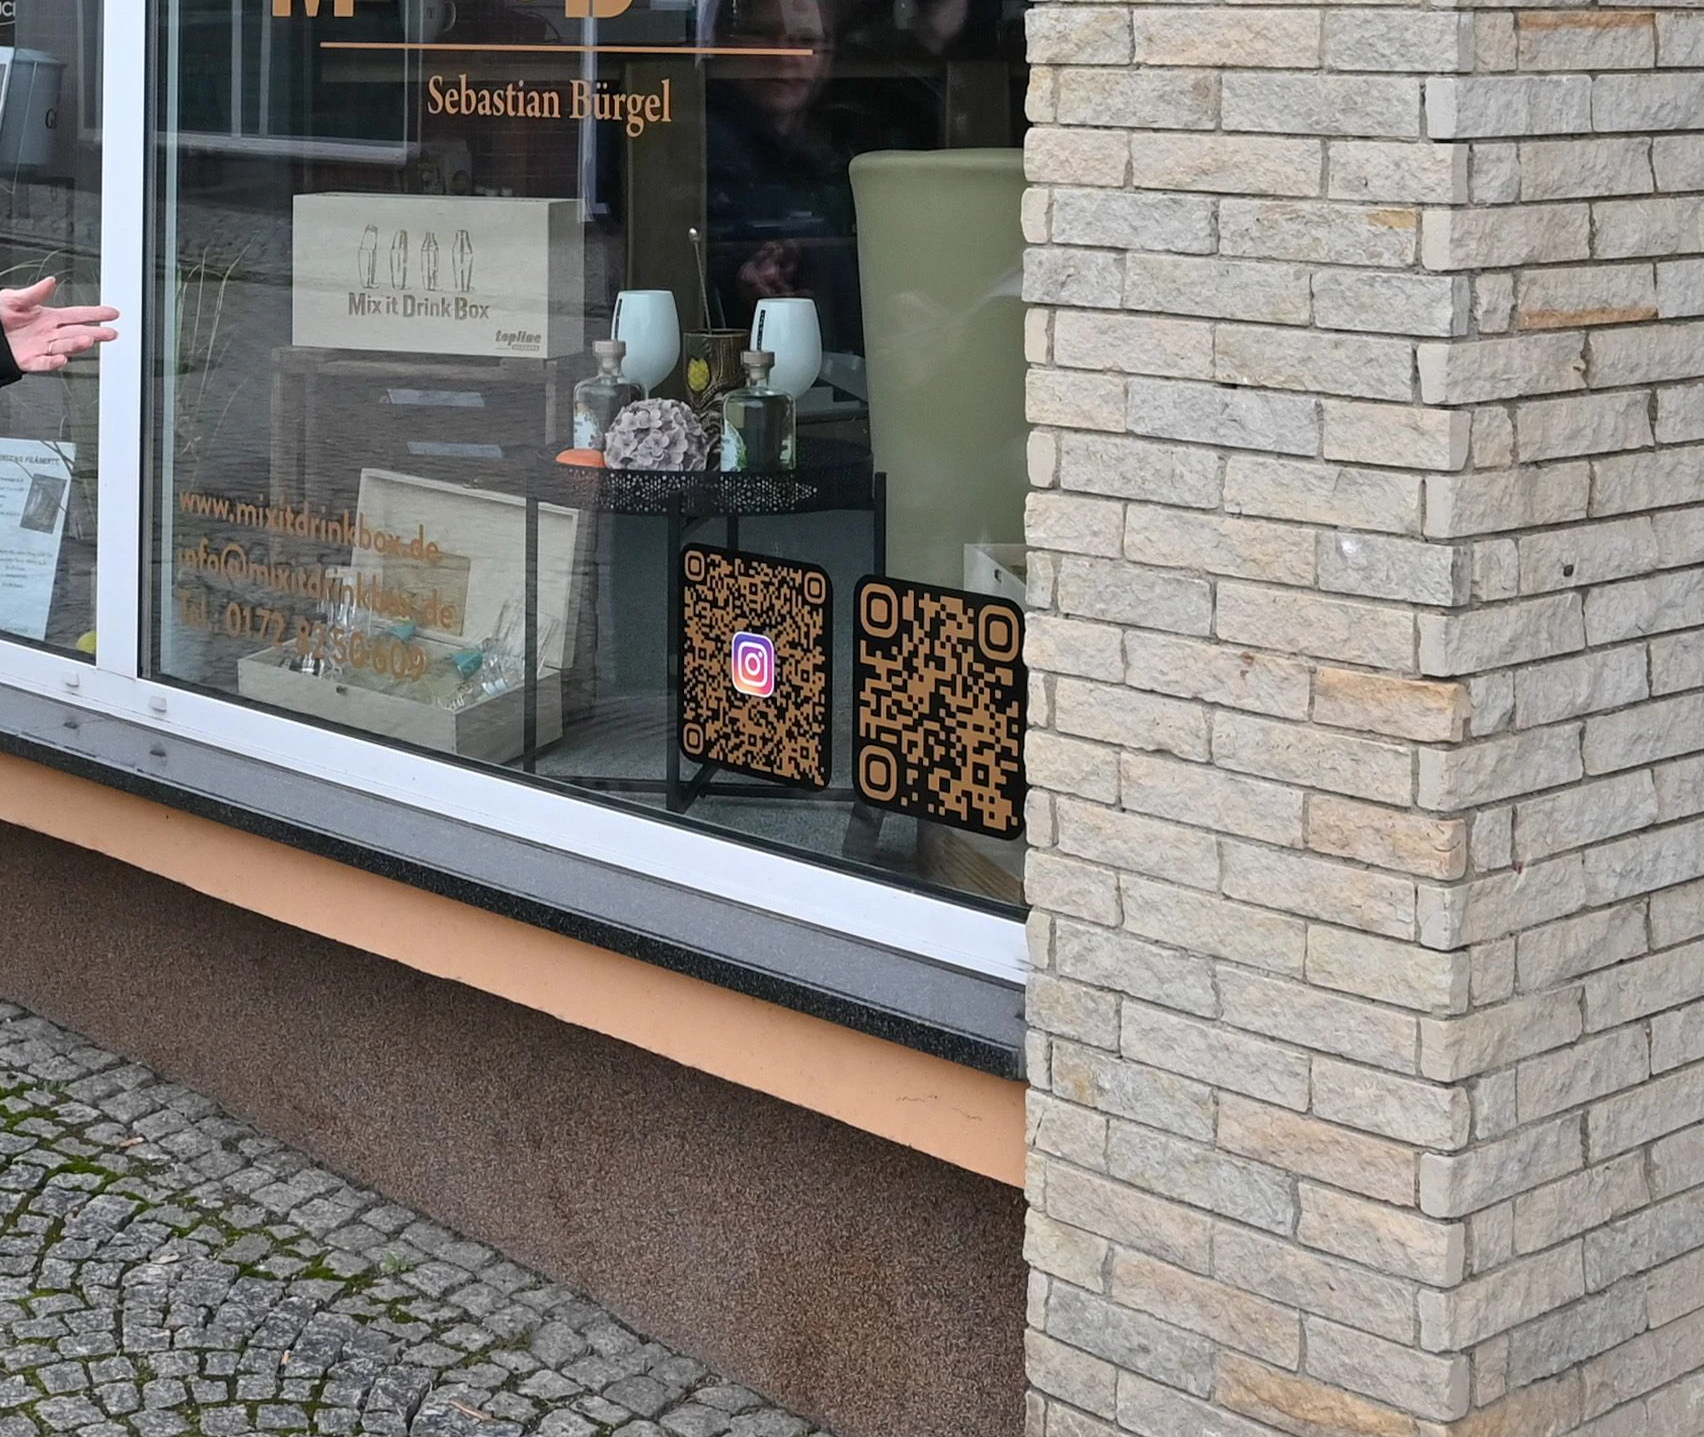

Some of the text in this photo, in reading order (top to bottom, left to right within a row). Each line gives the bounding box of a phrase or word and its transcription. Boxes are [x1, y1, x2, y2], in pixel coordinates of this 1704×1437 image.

[426, 74, 673, 139] Sebastian Bürgel
[348, 292, 490, 321] Mix it Drink Box
[178, 489, 442, 562] www.mixitdrinkbox.de
